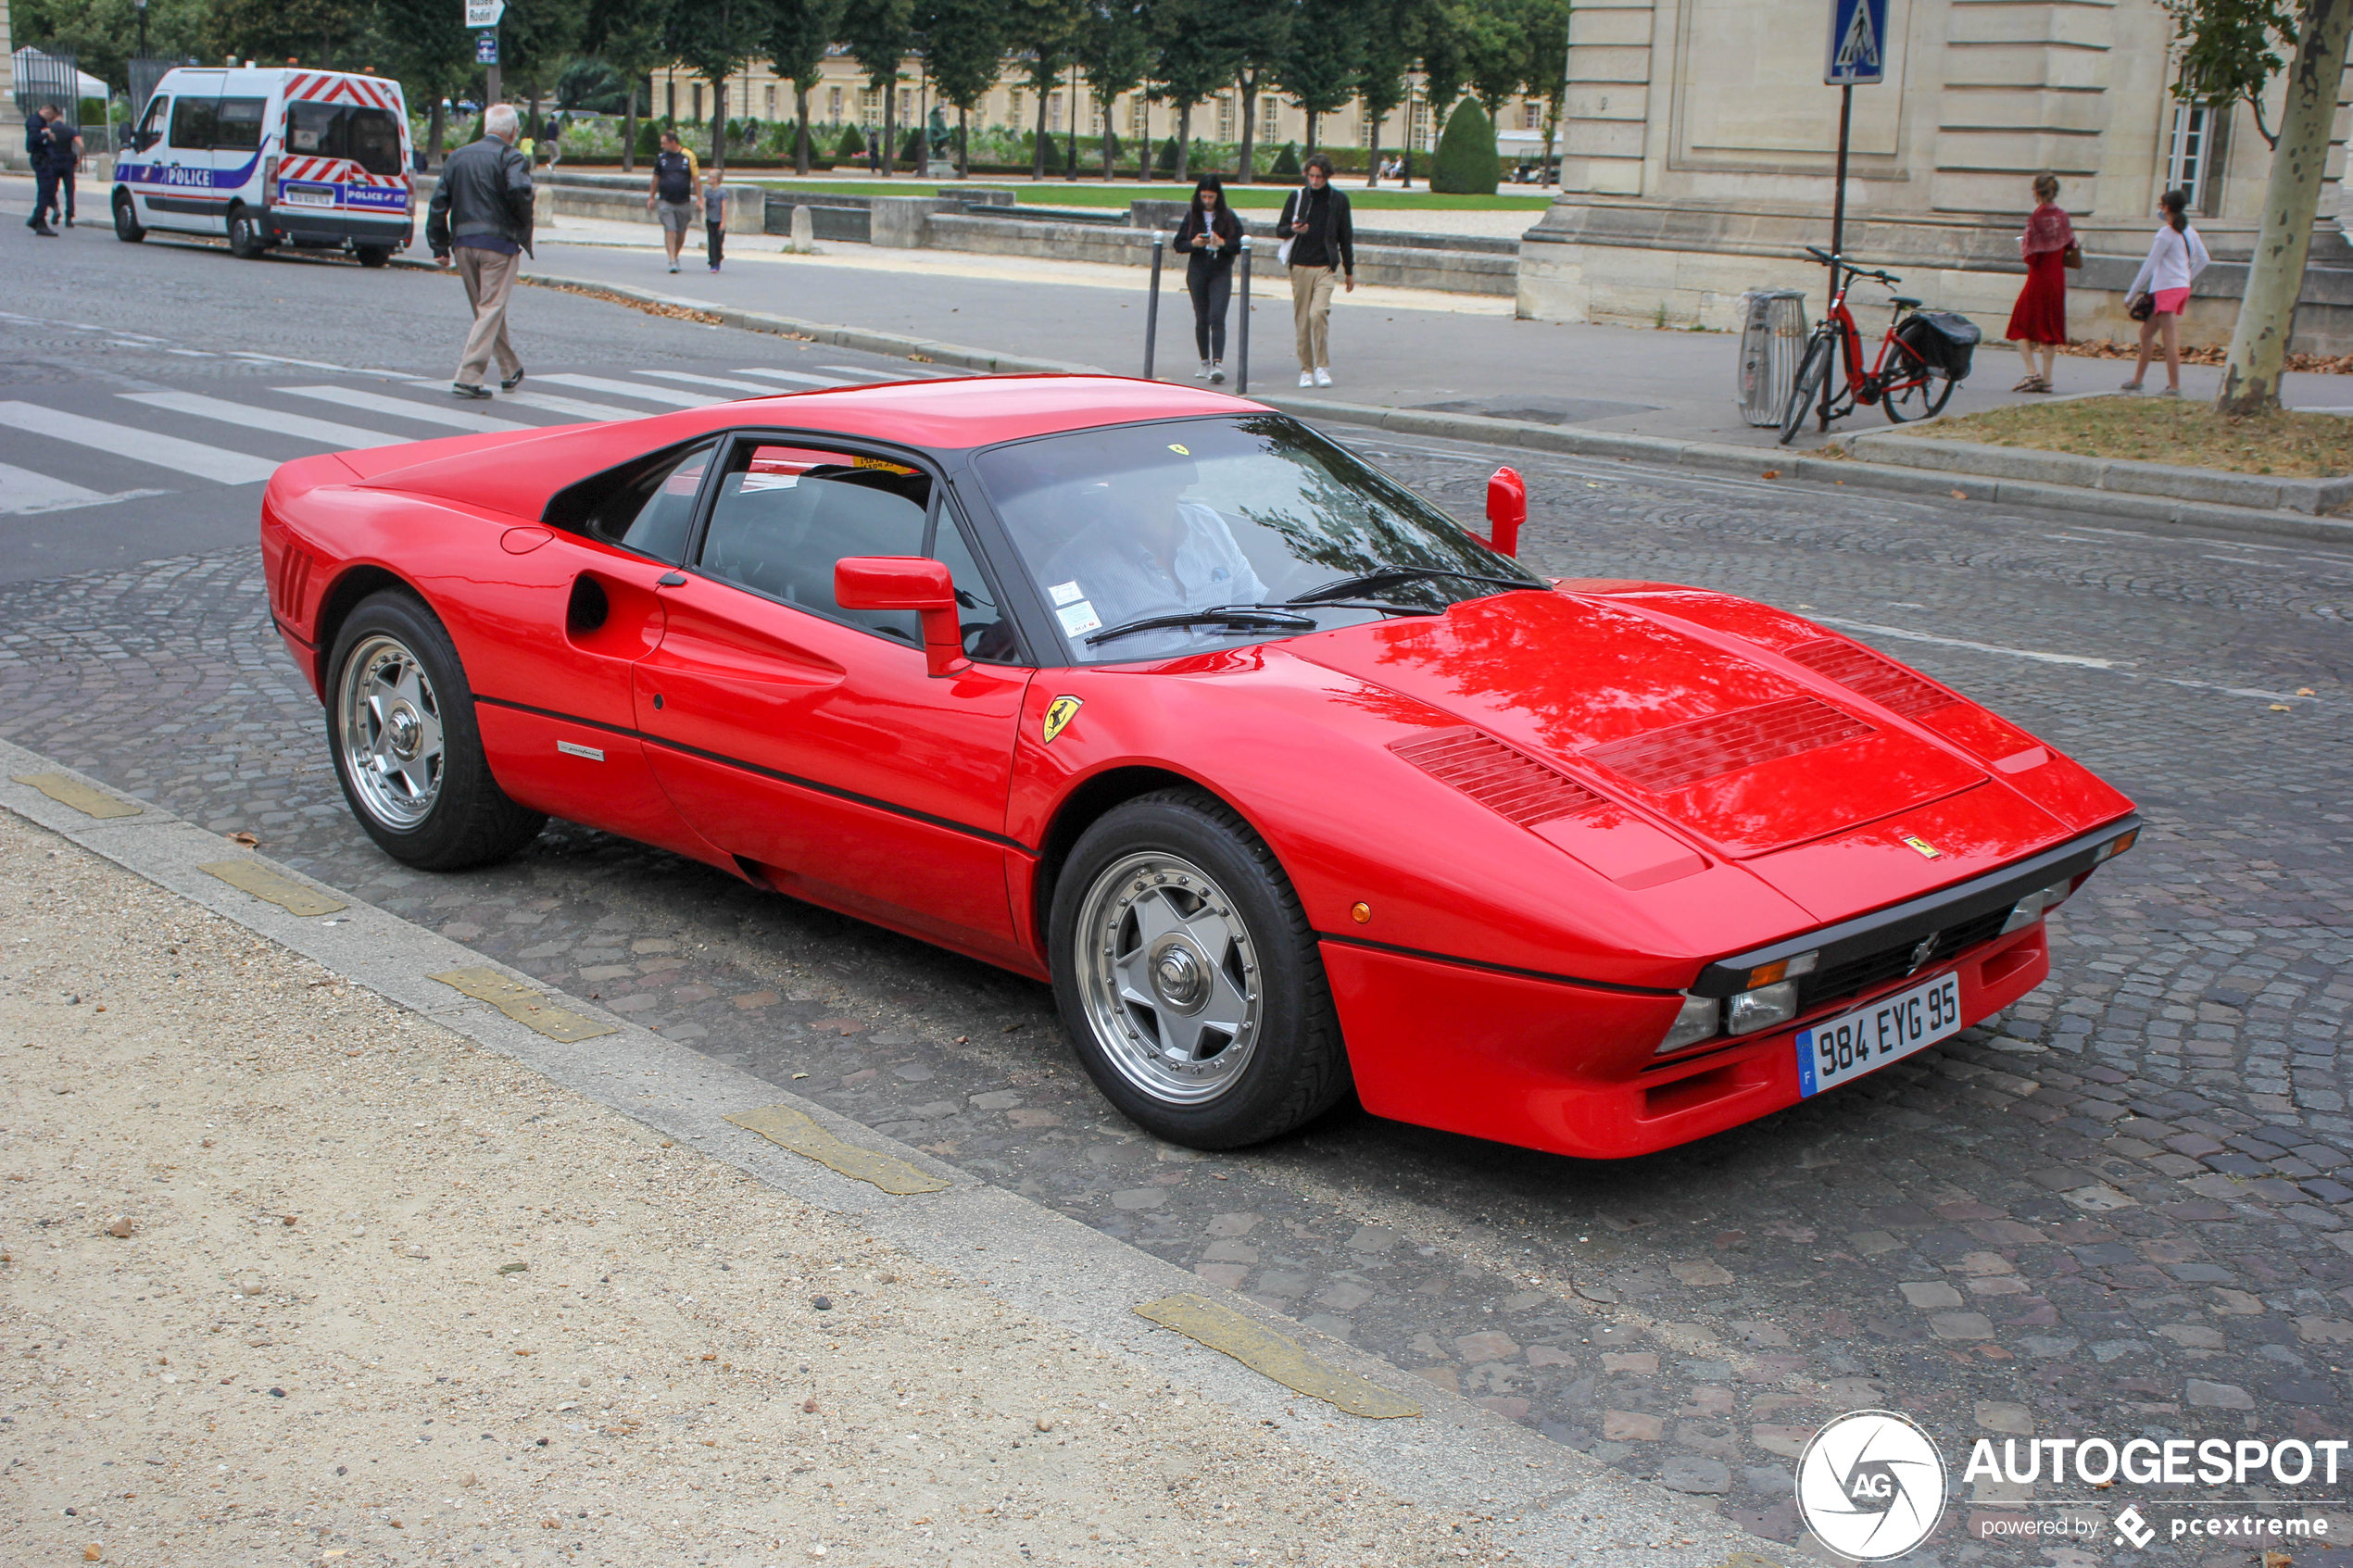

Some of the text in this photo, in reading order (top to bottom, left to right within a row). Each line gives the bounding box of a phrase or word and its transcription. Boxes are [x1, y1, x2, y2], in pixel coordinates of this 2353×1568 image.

[469, 9, 490, 21] Rodin
[168, 169, 210, 186] POLICE
[347, 191, 383, 201] POLICE
[1818, 981, 1957, 1077] 984 EYG 95
[1804, 1071, 1811, 1085] F
